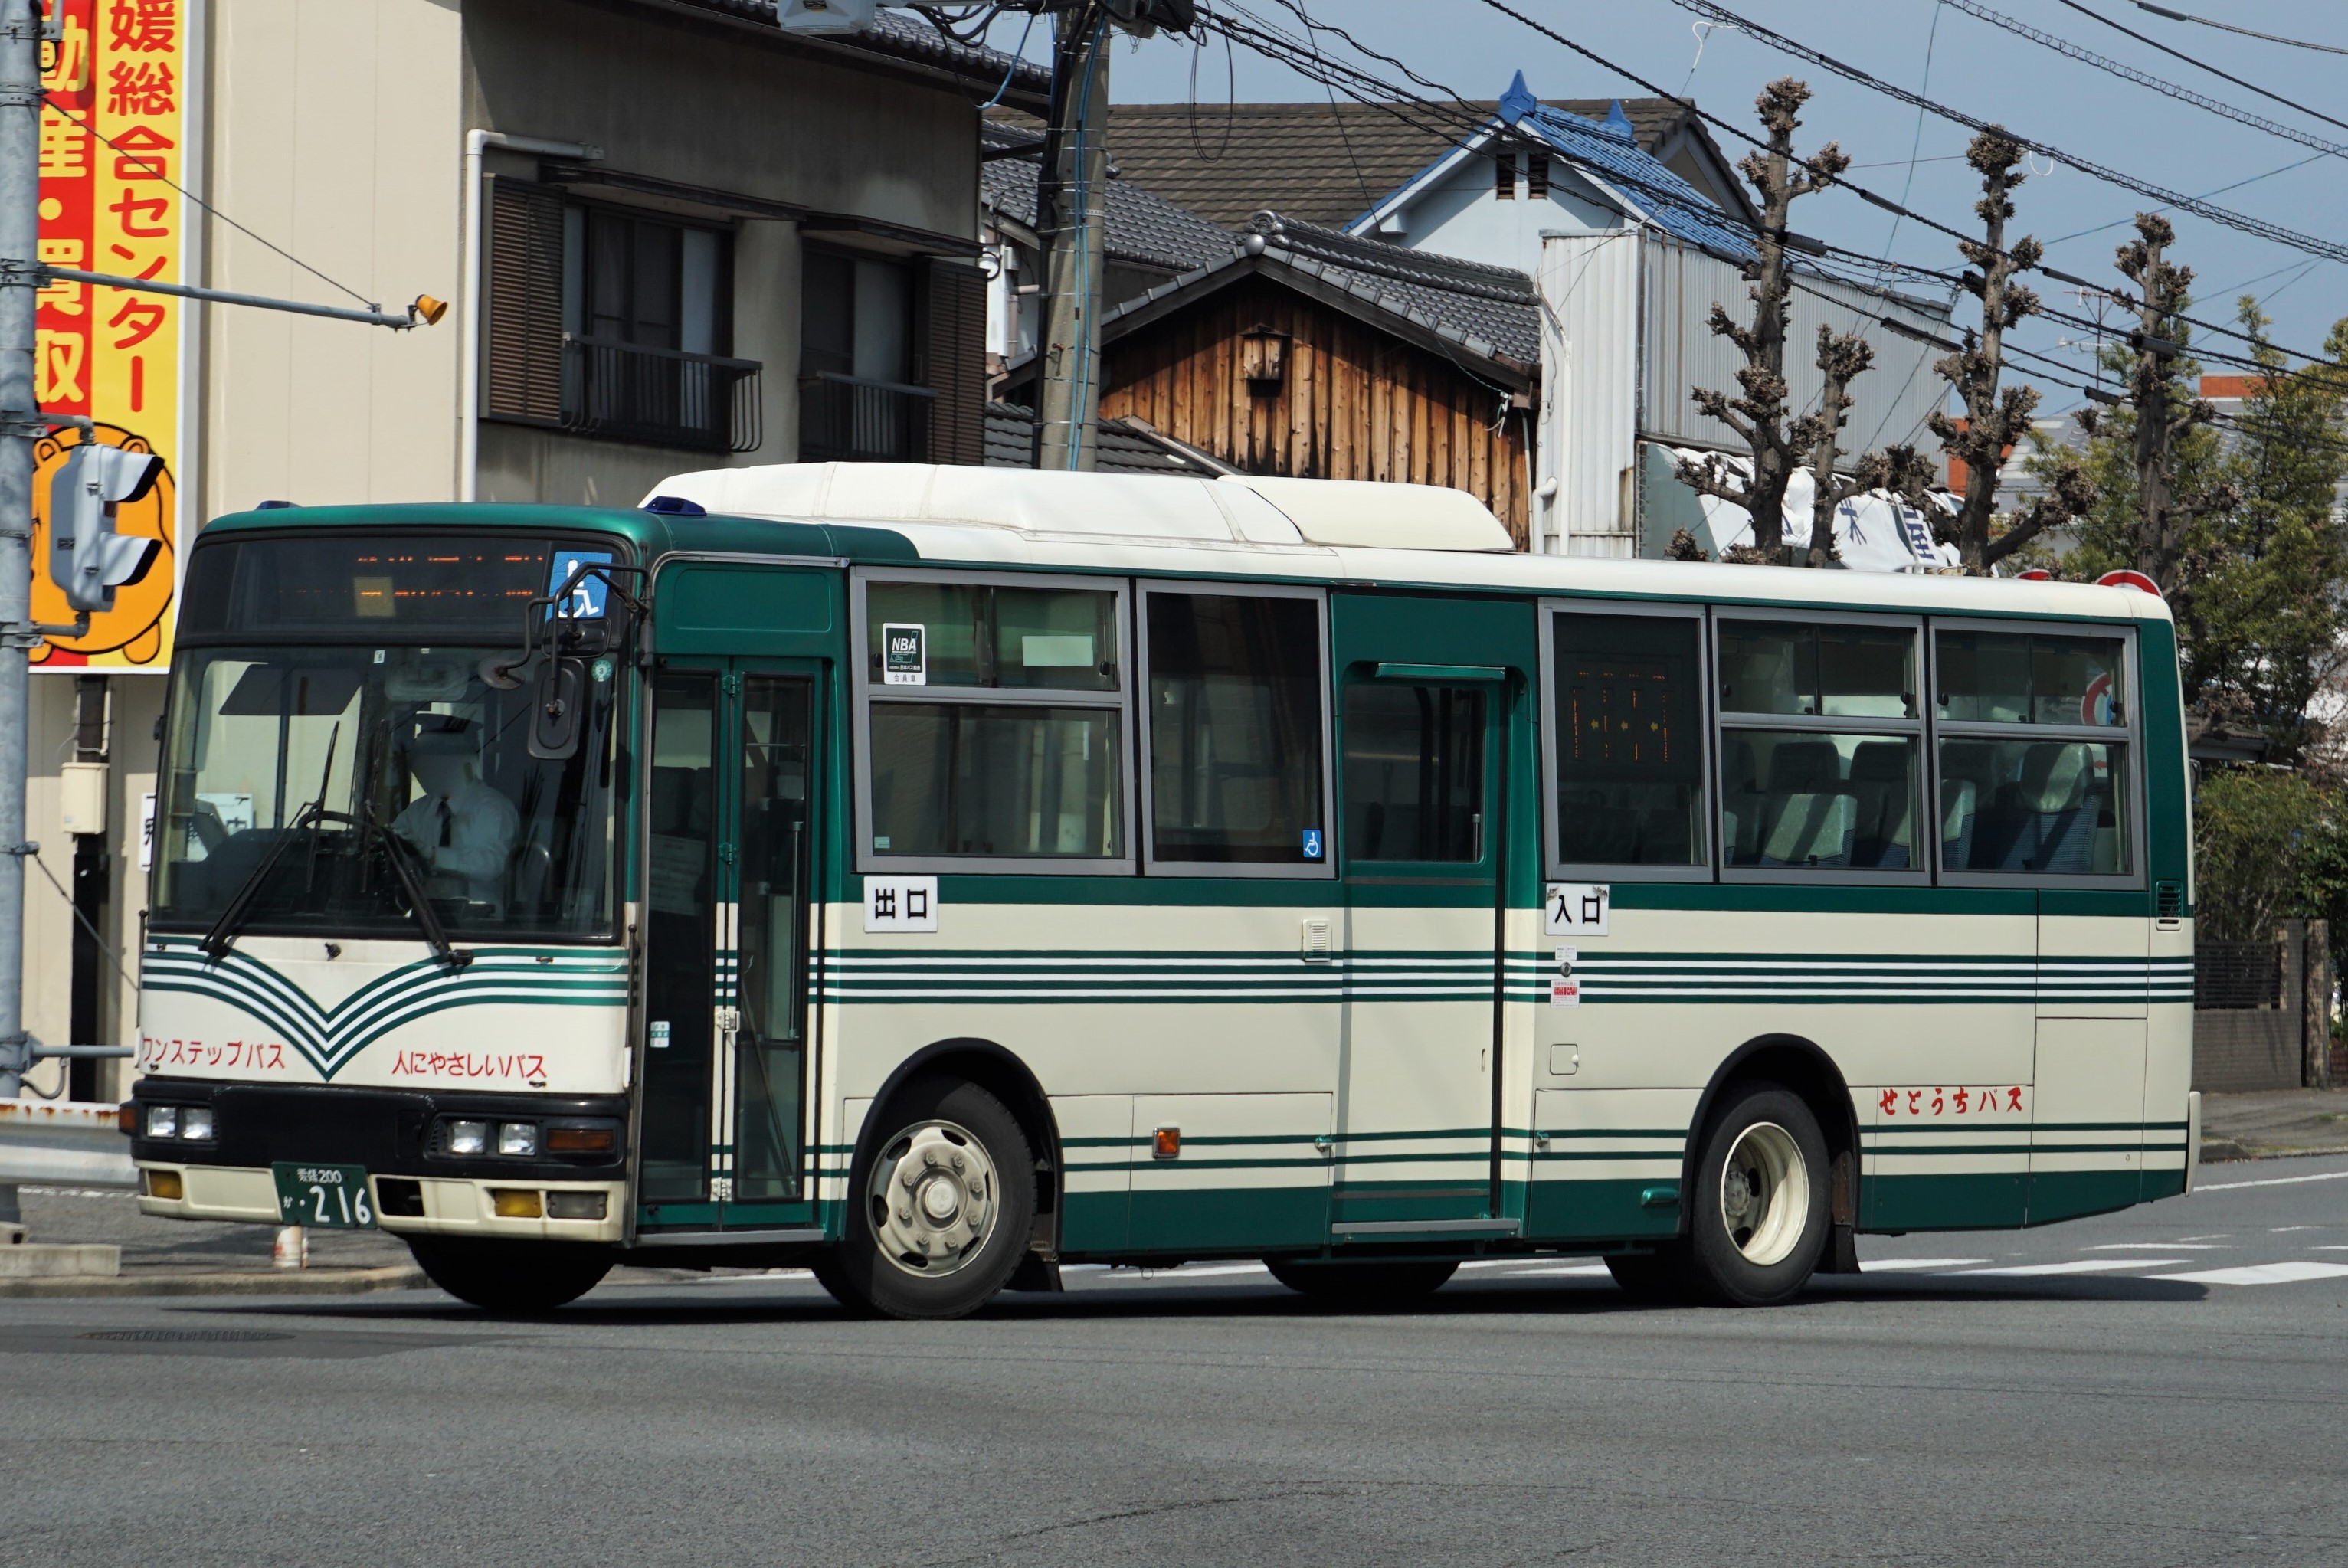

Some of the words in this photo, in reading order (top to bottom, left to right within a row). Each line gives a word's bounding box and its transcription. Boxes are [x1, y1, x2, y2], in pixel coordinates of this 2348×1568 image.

[107, 0, 175, 412] 媛総合センター
[892, 637, 918, 651] NBA
[875, 888, 927, 920] 出口
[1554, 895, 1601, 925] 入口
[142, 1038, 285, 1069] ワンステップバス
[391, 1050, 547, 1079] 人にやさしいバス
[1879, 1086, 2022, 1116] せとうちバス
